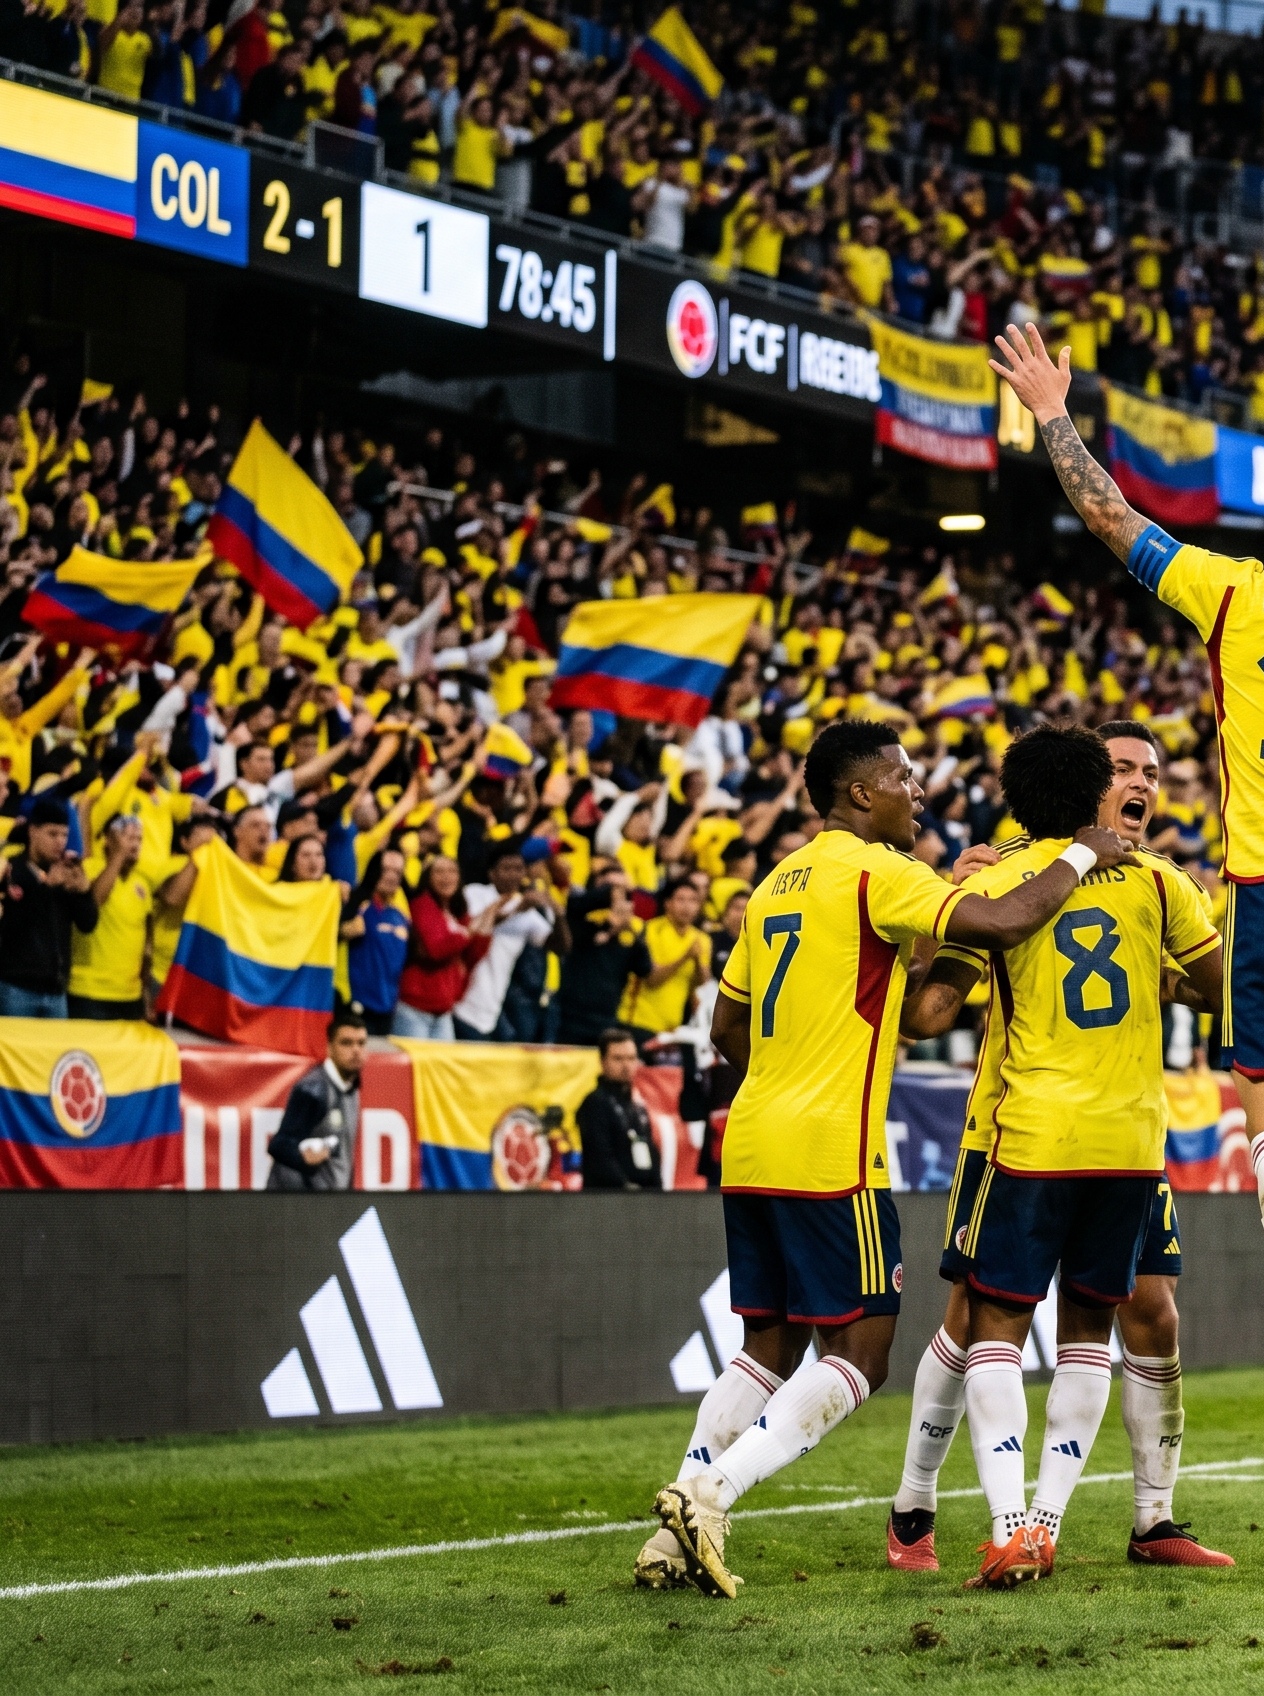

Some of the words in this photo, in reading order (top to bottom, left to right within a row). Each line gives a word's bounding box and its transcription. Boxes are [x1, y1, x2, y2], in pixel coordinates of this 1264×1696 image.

[151, 153, 231, 236] COL
[415, 219, 430, 293] 1
[496, 244, 596, 332] 78:45
[729, 313, 786, 374] FCF
[761, 912, 802, 1037] 7
[1053, 906, 1131, 1030] 8
[920, 1421, 954, 1438] FCF
